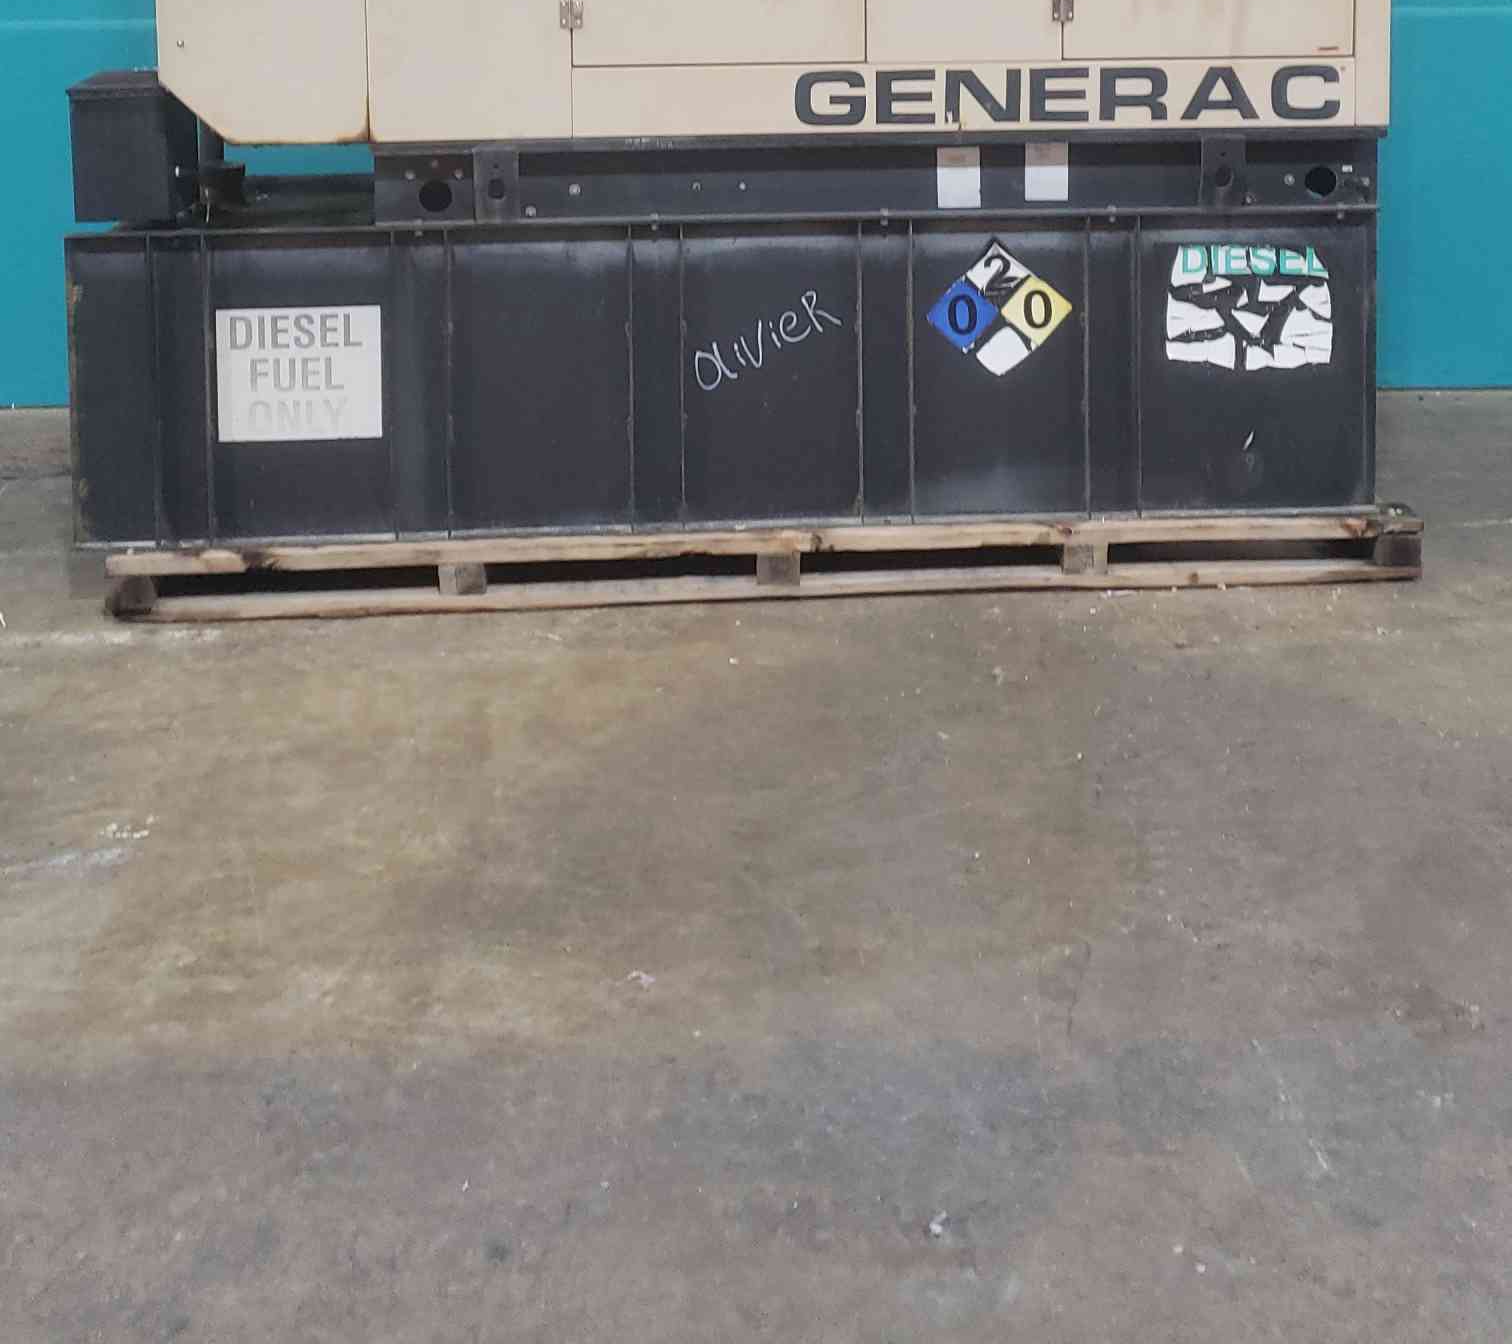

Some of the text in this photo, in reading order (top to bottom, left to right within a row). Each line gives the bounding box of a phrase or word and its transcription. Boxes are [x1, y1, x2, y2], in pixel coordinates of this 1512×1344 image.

[794, 65, 1341, 126] GENERAC
[983, 254, 1019, 296] 2
[1182, 244, 1328, 276] DIESEL
[229, 312, 363, 350] DIESEL
[947, 289, 1053, 335] 0 0
[250, 356, 344, 392] FUEL
[248, 396, 348, 434] ONLY
